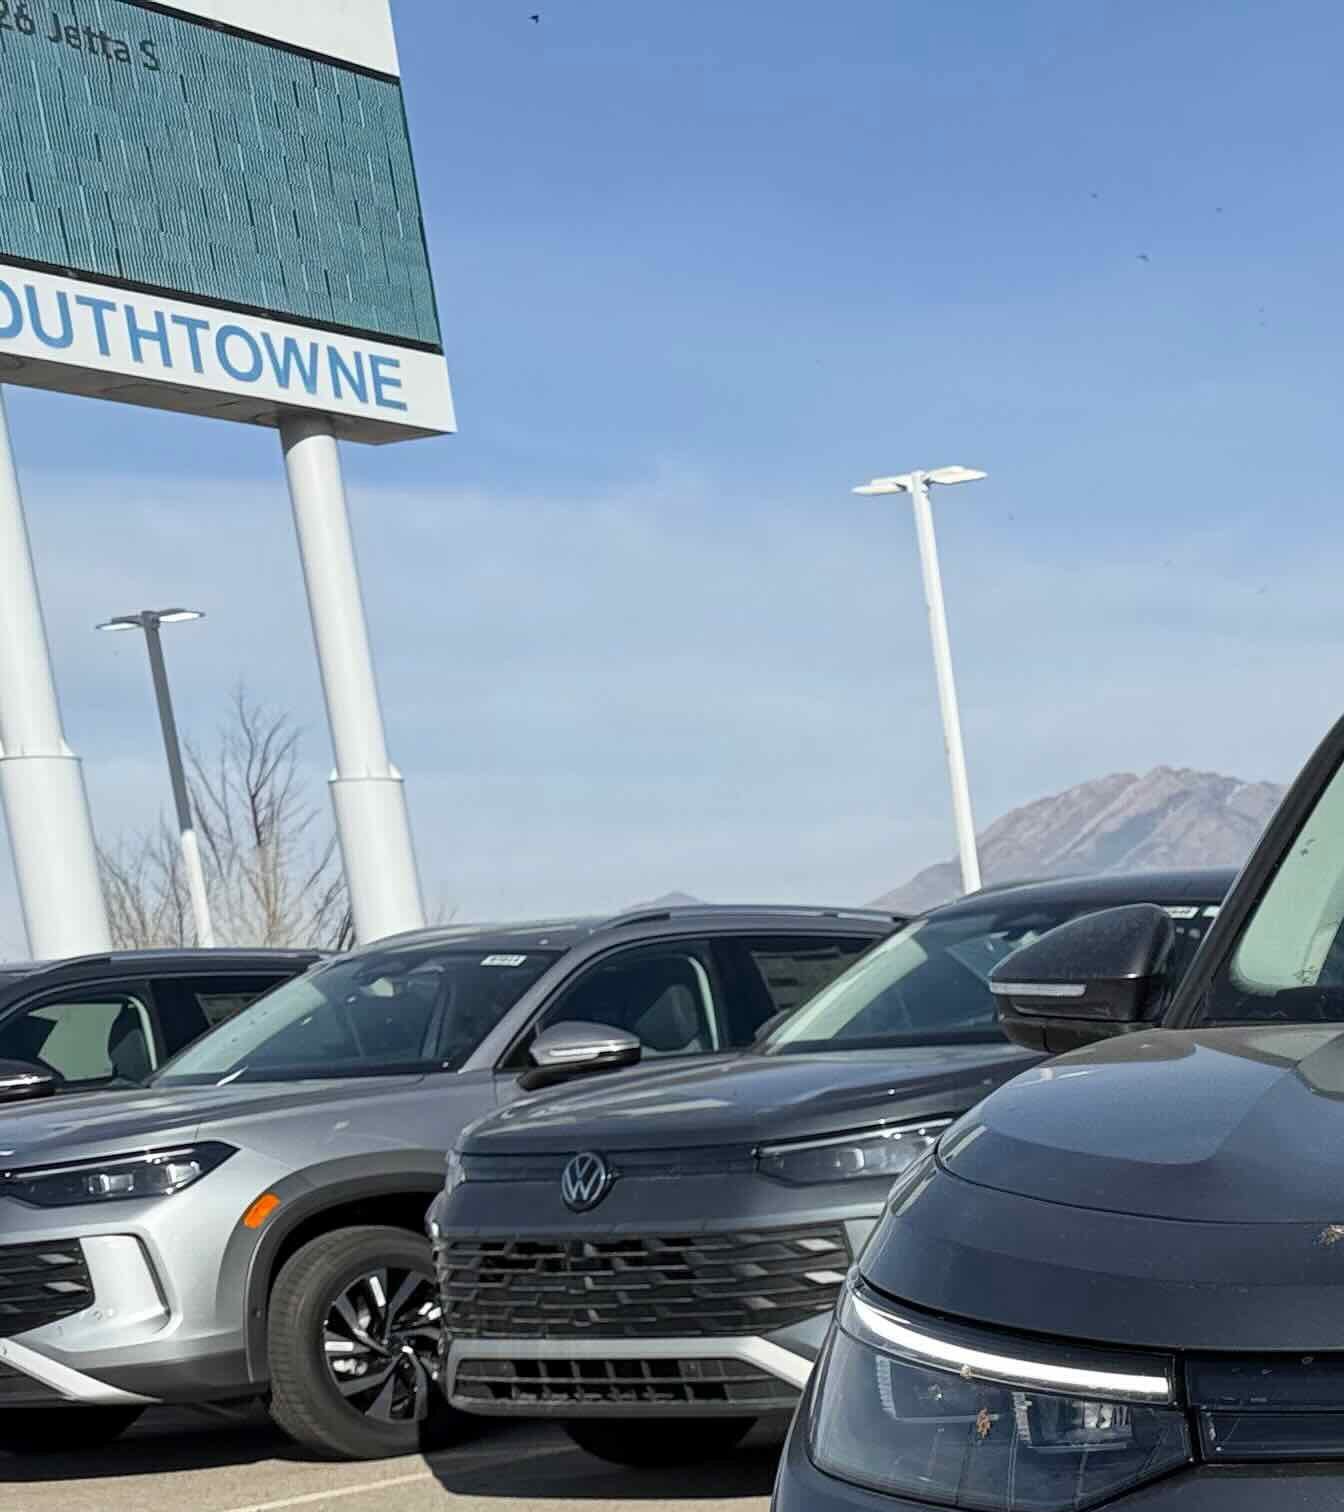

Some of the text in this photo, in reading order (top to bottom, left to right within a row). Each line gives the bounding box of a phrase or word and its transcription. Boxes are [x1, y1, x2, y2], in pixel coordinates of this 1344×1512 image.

[48, 12, 131, 64] Jetta
[139, 39, 160, 71] S
[562, 1153, 605, 1202] VW
